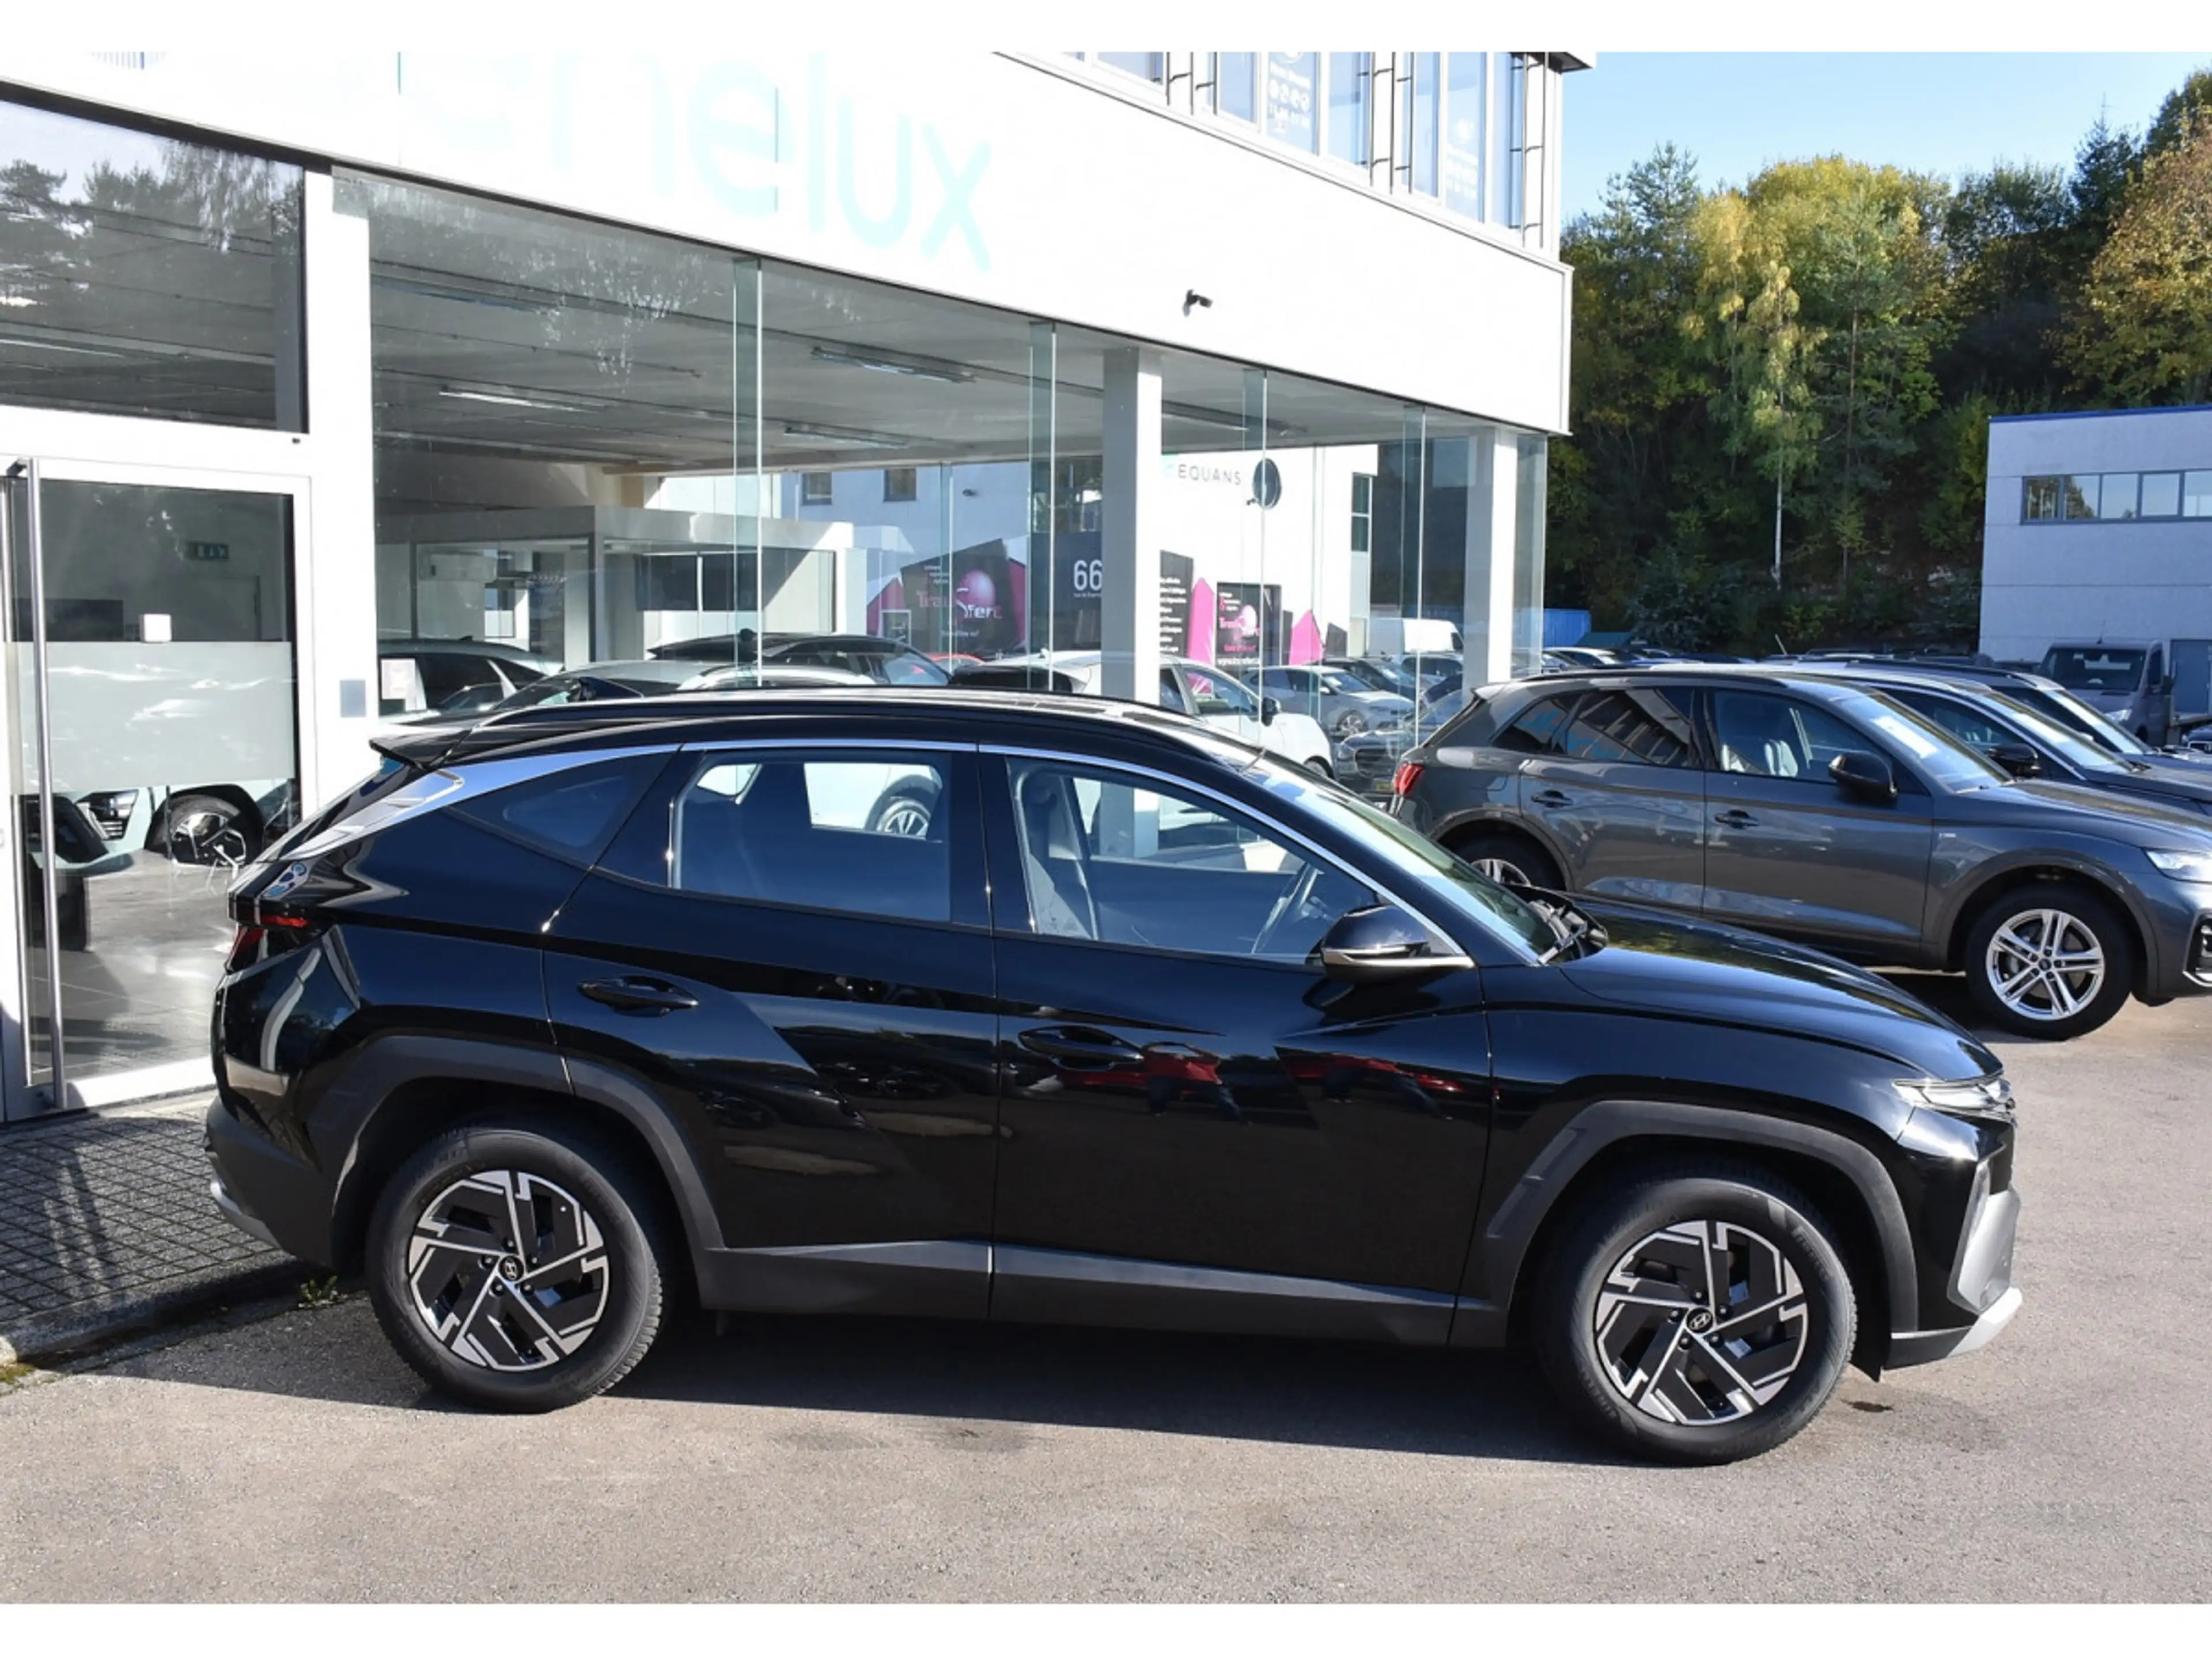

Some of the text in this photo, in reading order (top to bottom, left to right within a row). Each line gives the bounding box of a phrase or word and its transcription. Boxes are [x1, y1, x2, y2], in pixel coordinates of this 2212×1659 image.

[397, 52, 993, 274] enelux
[1178, 464, 1241, 486] EQUANS
[1074, 559, 1103, 591] 66
